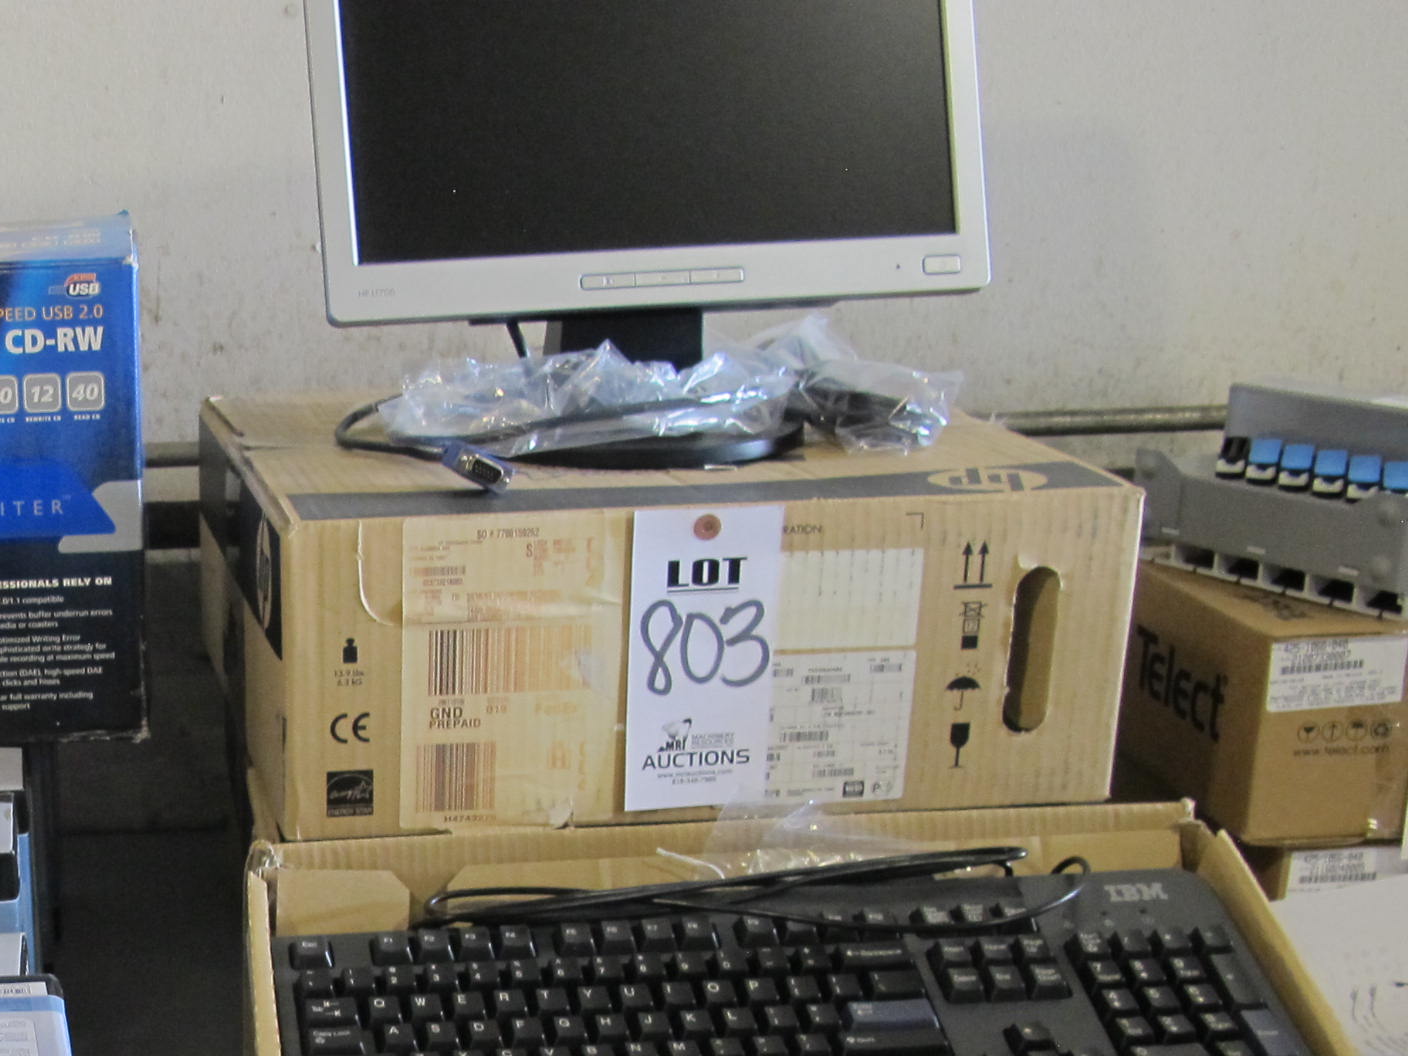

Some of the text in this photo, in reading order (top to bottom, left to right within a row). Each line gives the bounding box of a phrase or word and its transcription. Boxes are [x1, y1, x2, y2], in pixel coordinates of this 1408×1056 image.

[68, 284, 100, 296] USB
[42, 306, 72, 320] USB
[79, 305, 103, 319] 2.0
[5, 327, 103, 354] CD-RW
[31, 386, 54, 402] 12
[72, 383, 98, 400] 40
[667, 557, 748, 588] LOT
[63, 578, 91, 587] RELY
[95, 577, 112, 585] ON
[54, 609, 89, 617] underrun
[32, 634, 60, 644] Writing
[62, 633, 80, 641] Error
[640, 599, 770, 696] 803
[430, 707, 463, 720] GND
[330, 712, 370, 744] CE
[429, 718, 481, 729] PREPAID
[666, 740, 686, 751] MRI
[642, 749, 750, 771] AUCTIONS
[1104, 882, 1168, 901] IBM
[415, 980, 759, 1007] W E R T Y U O P
[389, 1026, 399, 1034] A
[474, 1023, 484, 1032] D
[600, 1017, 611, 1026] H
[685, 1013, 696, 1022] K
[727, 1011, 737, 1021] L
[545, 1048, 554, 1056] V
[630, 1043, 642, 1051] N
[673, 1042, 686, 1051] M
